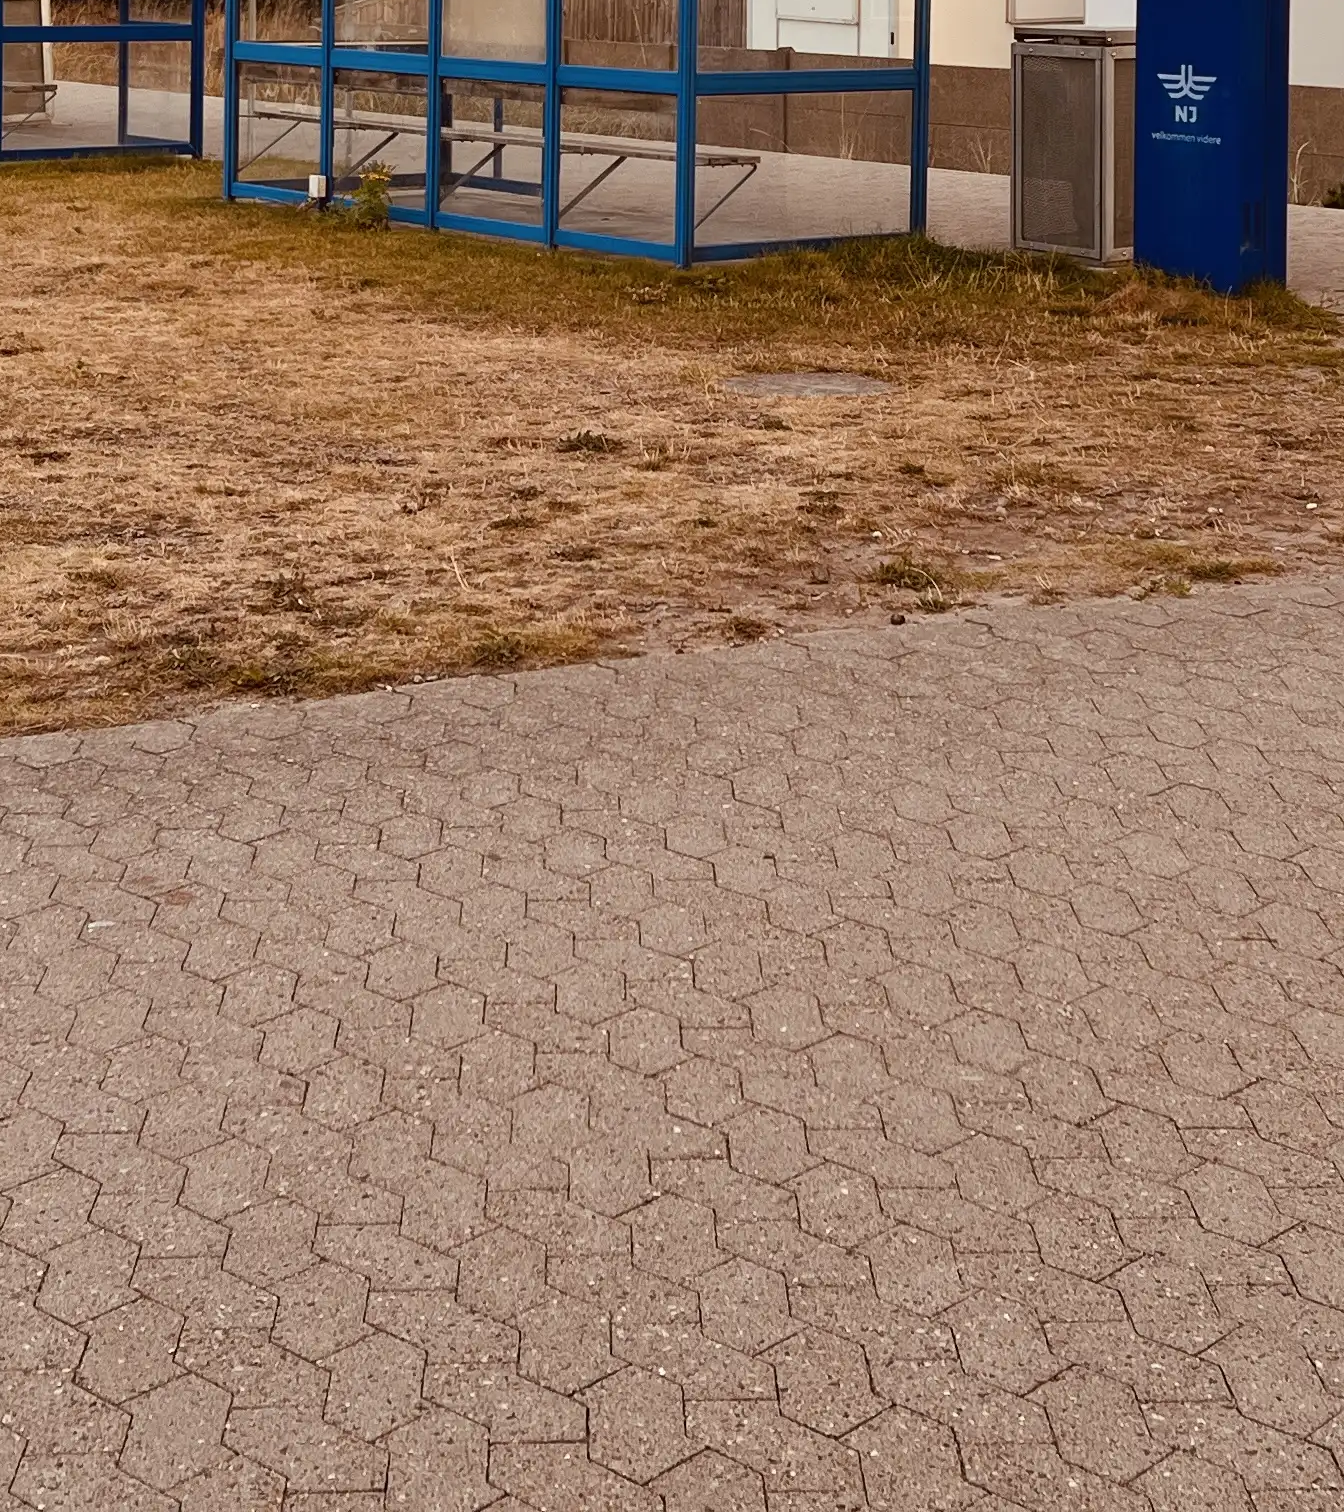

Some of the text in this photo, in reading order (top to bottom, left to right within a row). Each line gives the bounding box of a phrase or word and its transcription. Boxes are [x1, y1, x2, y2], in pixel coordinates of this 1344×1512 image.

[1175, 104, 1198, 124] NJ
[1151, 131, 1222, 145] velkommen videre
